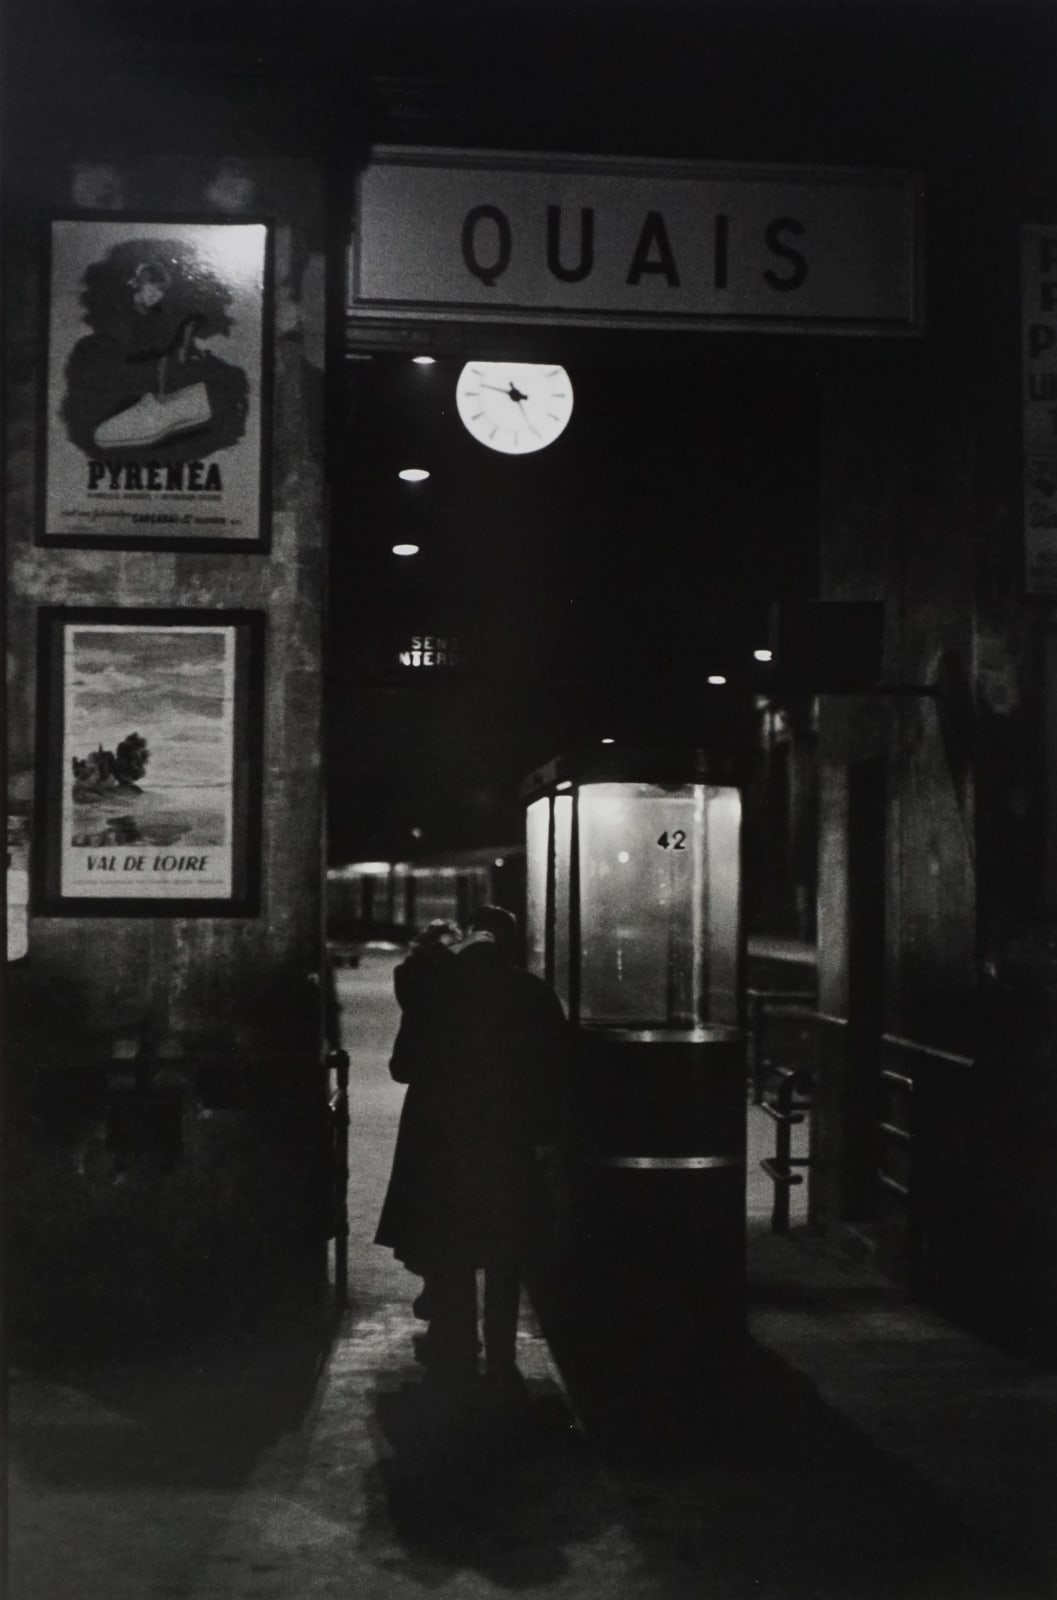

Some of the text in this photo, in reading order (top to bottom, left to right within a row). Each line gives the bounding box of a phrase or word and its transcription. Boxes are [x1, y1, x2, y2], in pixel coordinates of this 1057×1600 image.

[461, 205, 808, 292] QUAIS
[657, 829, 686, 850] 42
[87, 855, 210, 872] VAL DE LOIRE
